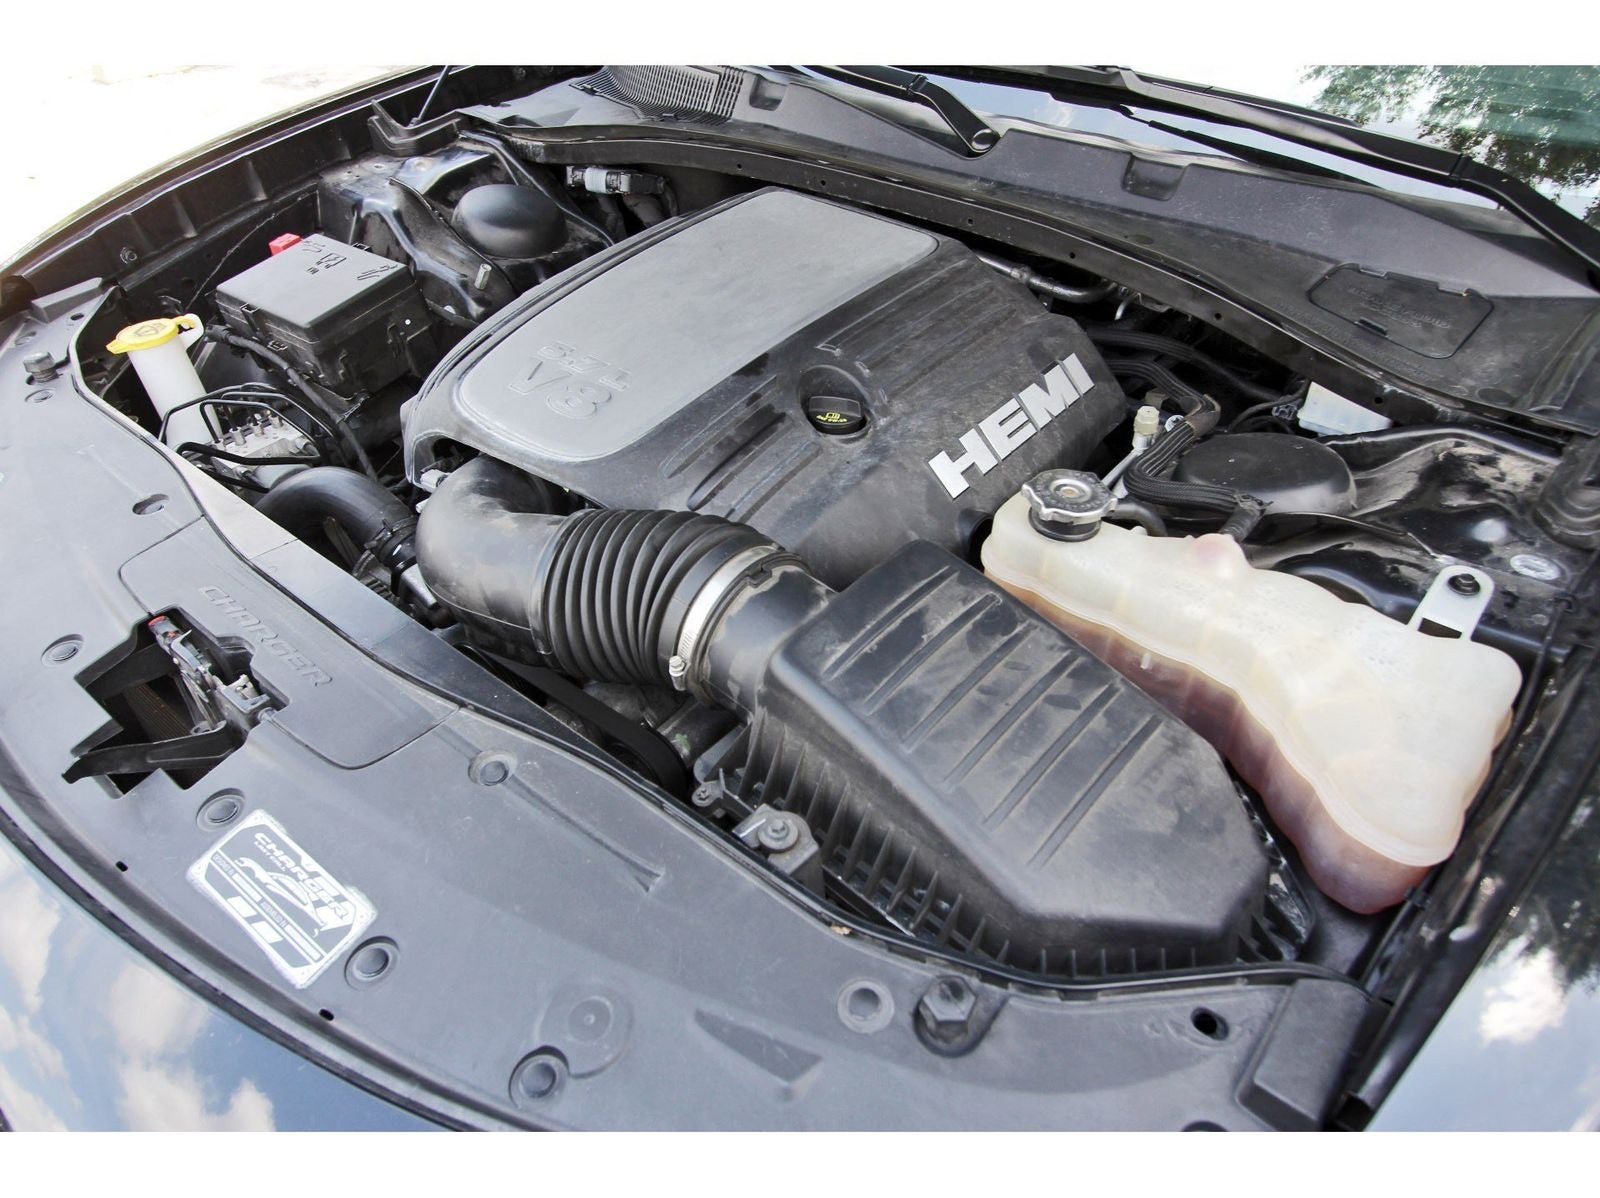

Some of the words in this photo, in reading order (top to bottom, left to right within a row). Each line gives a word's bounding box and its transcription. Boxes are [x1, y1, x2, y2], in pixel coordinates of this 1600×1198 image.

[508, 356, 612, 420] V8
[927, 352, 1095, 500] HEMI
[199, 586, 333, 687] CHARGER
[254, 832, 349, 921] CHARGER
